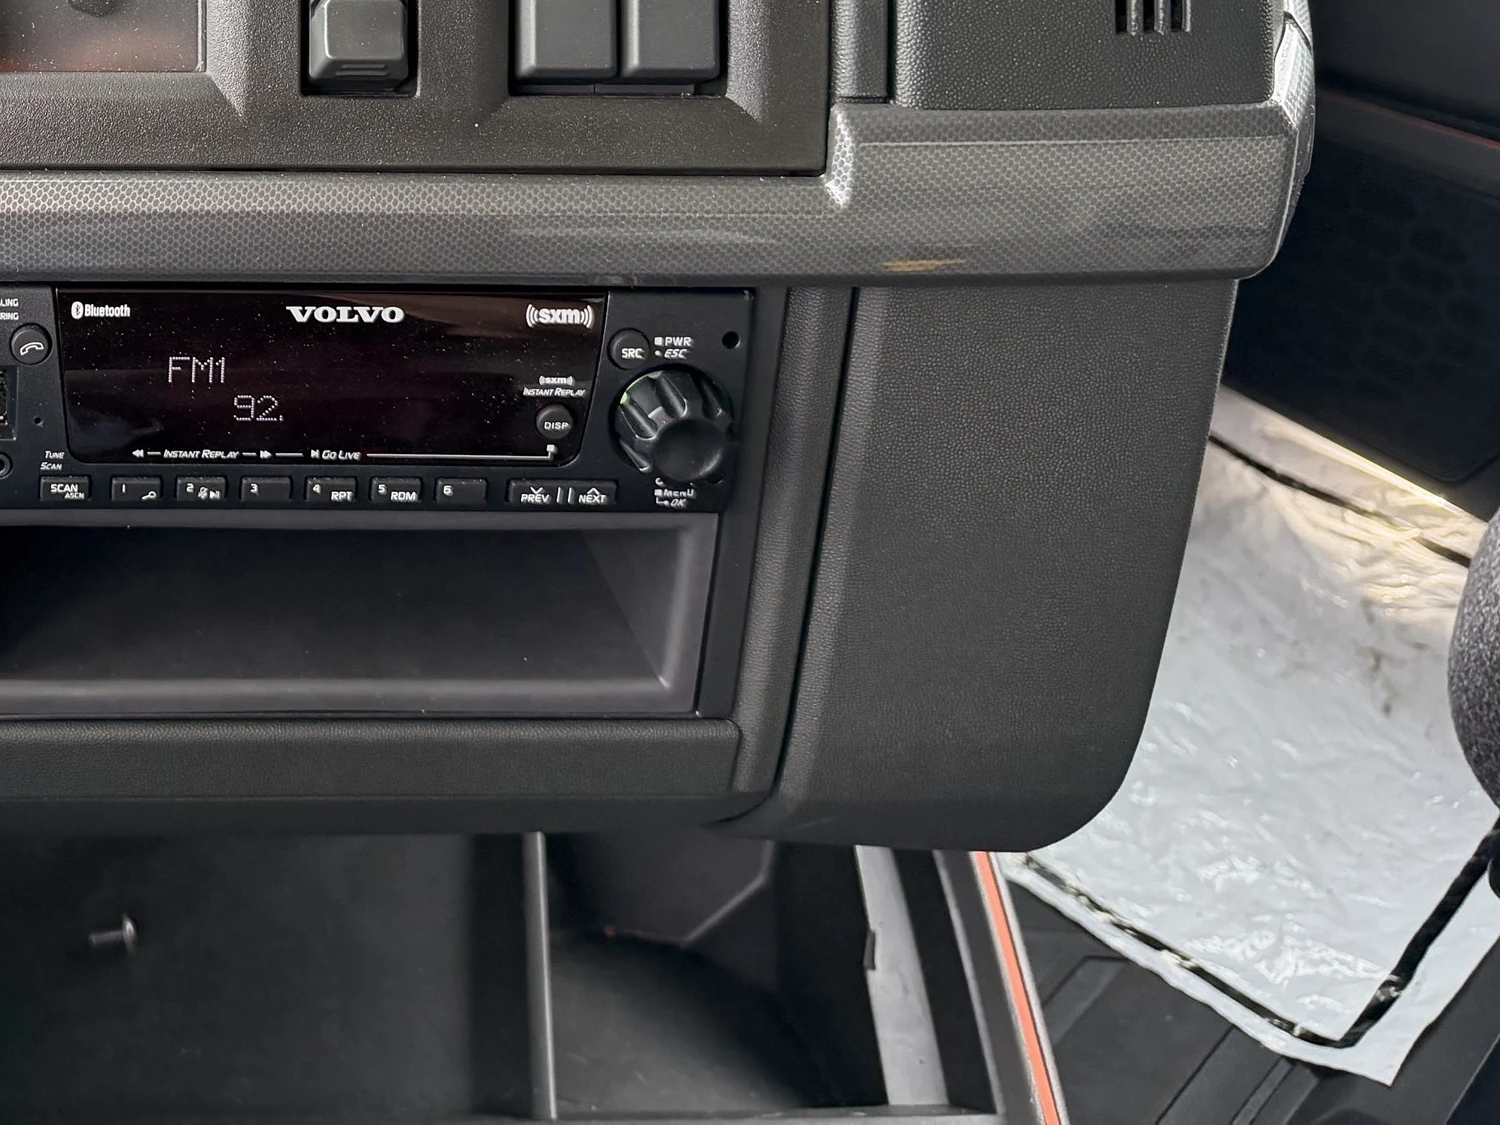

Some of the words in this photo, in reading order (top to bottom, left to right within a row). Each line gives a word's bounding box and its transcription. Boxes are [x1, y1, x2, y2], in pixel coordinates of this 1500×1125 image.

[84, 304, 131, 318] Bluetooth
[286, 306, 404, 323] VOLVO
[664, 336, 692, 347] PWR
[621, 348, 644, 359] SRC
[664, 348, 688, 359] ESC
[167, 356, 226, 384] FM1
[544, 421, 569, 431] DISP
[50, 483, 78, 494] SCAN
[187, 483, 194, 493] 2
[250, 484, 258, 494] 3
[313, 484, 321, 493] 4
[378, 485, 386, 494] 5
[443, 486, 451, 496] 6
[64, 492, 85, 500] ASCN
[331, 491, 353, 502] RPT
[391, 491, 417, 502] RDM
[521, 494, 550, 504] PREV
[578, 494, 606, 504] NEXT
[670, 498, 686, 507] OK
